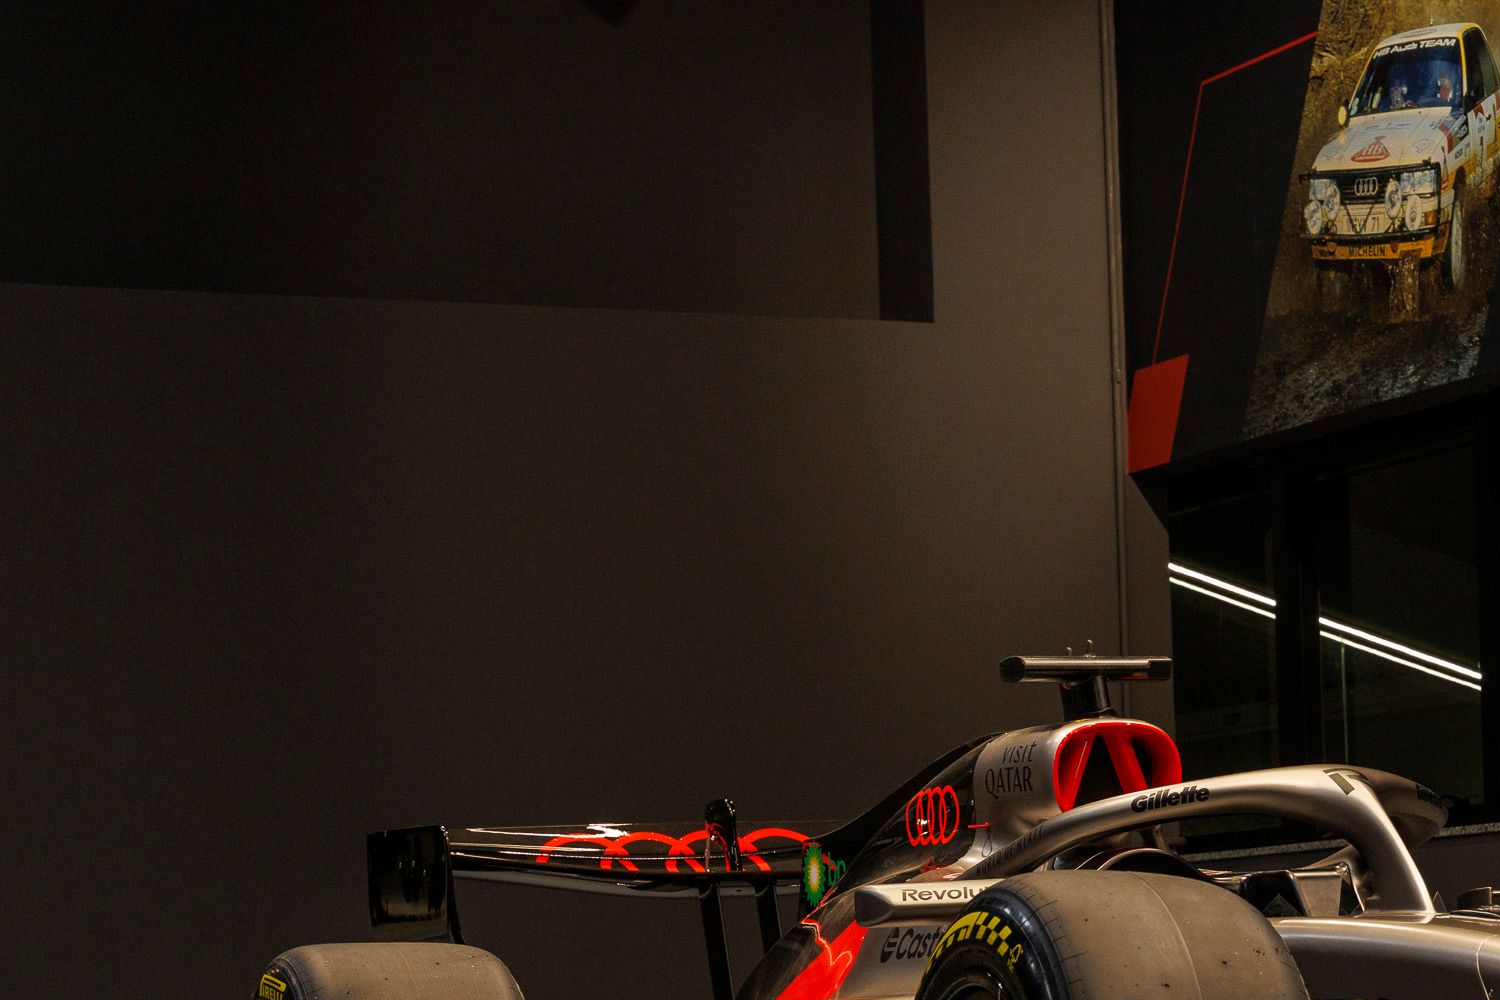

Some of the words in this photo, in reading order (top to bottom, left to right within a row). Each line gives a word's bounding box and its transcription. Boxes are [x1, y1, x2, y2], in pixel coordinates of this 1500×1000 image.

[1420, 38, 1457, 49] TEAM
[1002, 741, 1037, 766] visit
[985, 765, 1034, 796] QATAR
[1130, 785, 1210, 814] Gillette
[895, 928, 942, 960] Cast
